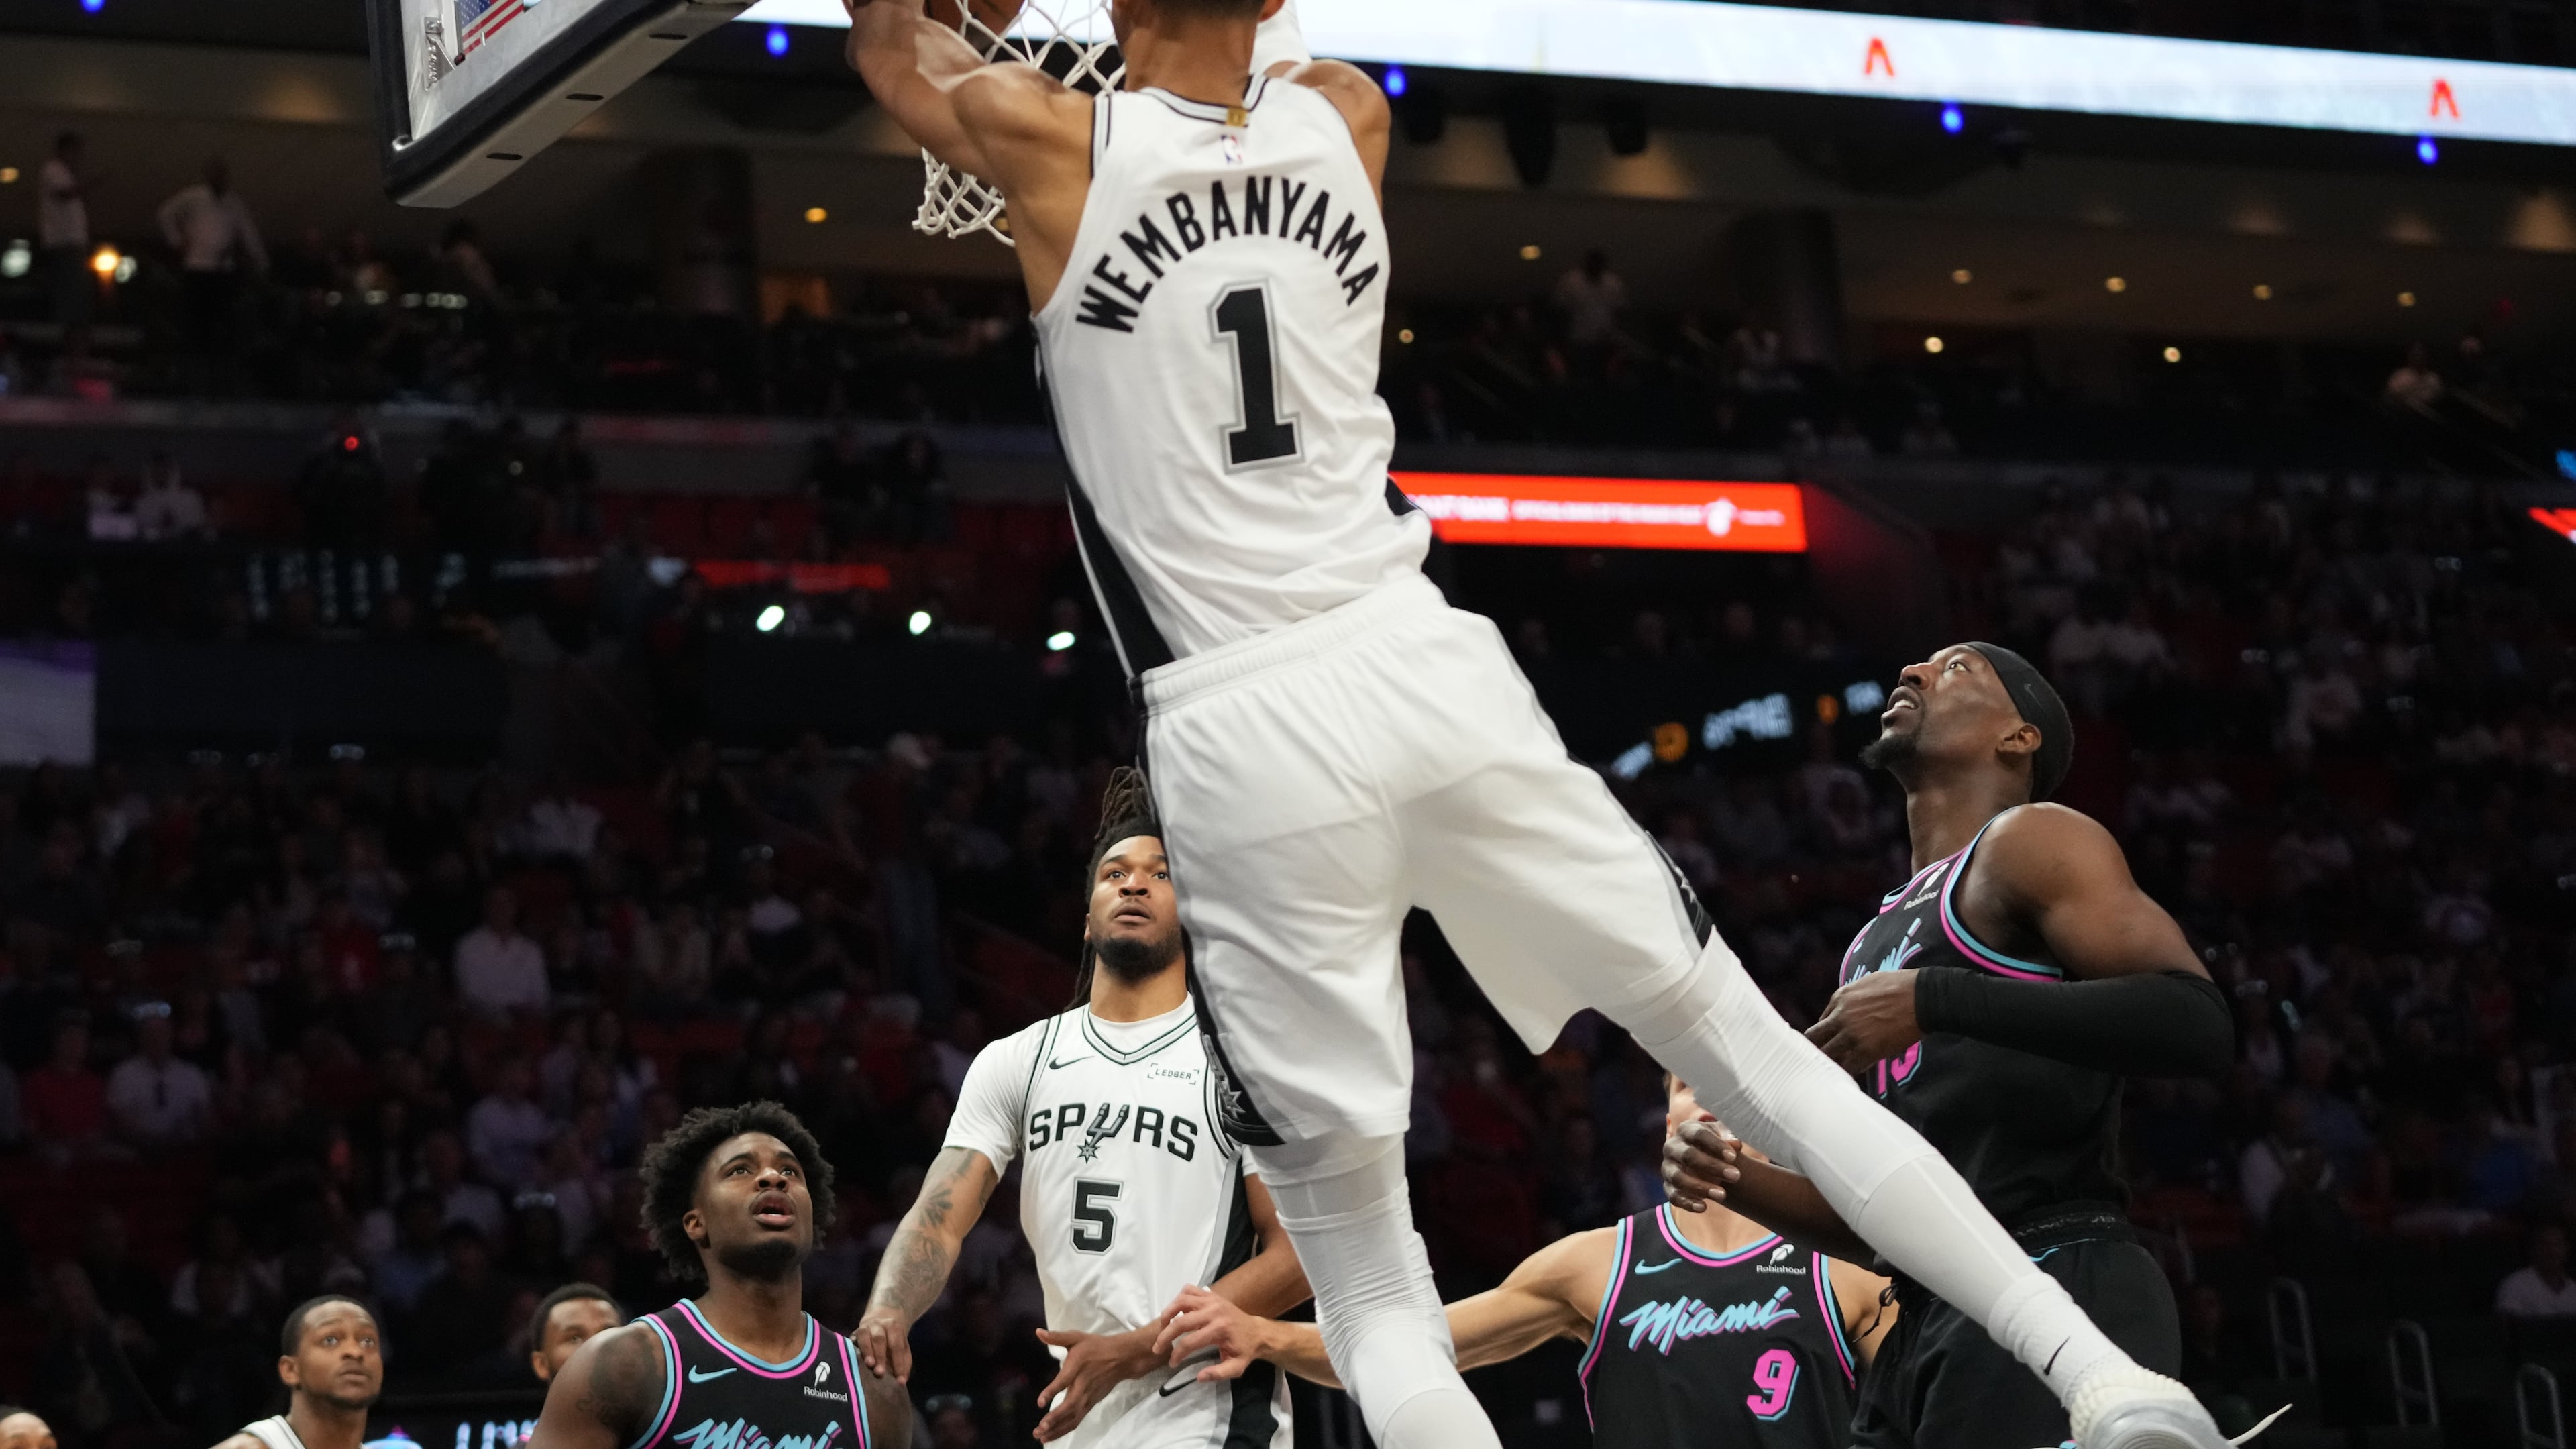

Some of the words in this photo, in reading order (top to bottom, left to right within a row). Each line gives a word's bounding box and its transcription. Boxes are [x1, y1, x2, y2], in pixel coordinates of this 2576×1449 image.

[1075, 175, 1379, 333] WEMBANYAMA
[1208, 277, 1305, 475] 1
[1155, 1068, 1192, 1079] LEDGER
[1029, 1102, 1198, 1163] SPURS
[1070, 1177, 1124, 1256] 5
[1756, 1264, 1806, 1275] Robinhood
[1619, 1286, 1800, 1356] Miami
[803, 1385, 849, 1403] Robinhood
[1746, 1348, 1800, 1421] 9
